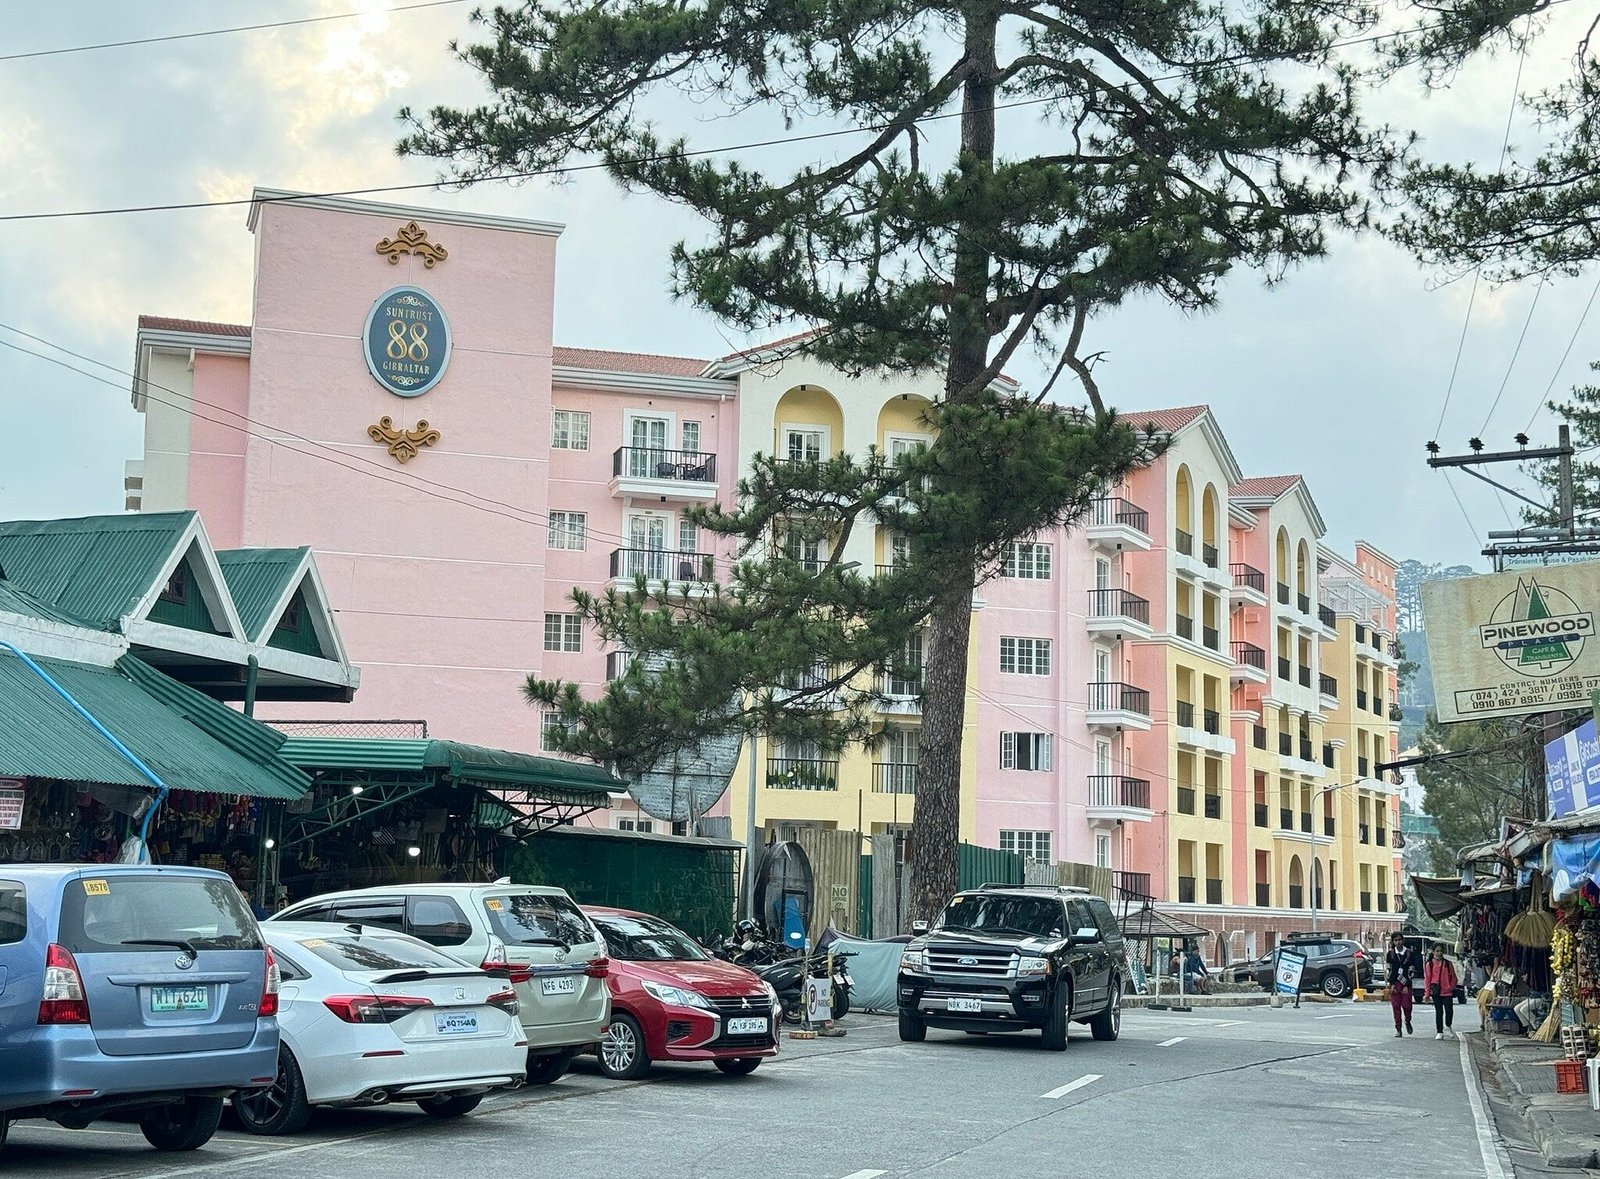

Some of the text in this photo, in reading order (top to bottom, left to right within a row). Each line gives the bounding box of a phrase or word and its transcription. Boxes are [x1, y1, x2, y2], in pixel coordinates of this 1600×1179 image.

[386, 306, 433, 321] SUNTRUST
[387, 319, 429, 361] 88
[382, 361, 430, 375] GIBRALTAR
[1540, 554, 1559, 565] Huse
[1483, 617, 1590, 641] PINEWOOD
[1508, 635, 1569, 647] PLACE
[1500, 675, 1579, 690] CONTACT NUMBERS
[1586, 679, 1600, 688] 87
[1472, 700, 1495, 709] 0910
[1520, 695, 1544, 704] 8915
[1557, 690, 1582, 700] 0995
[832, 886, 847, 896] NO
[558, 980, 574, 990] 4293
[183, 988, 204, 1004] 620
[964, 1001, 980, 1010] 3467
